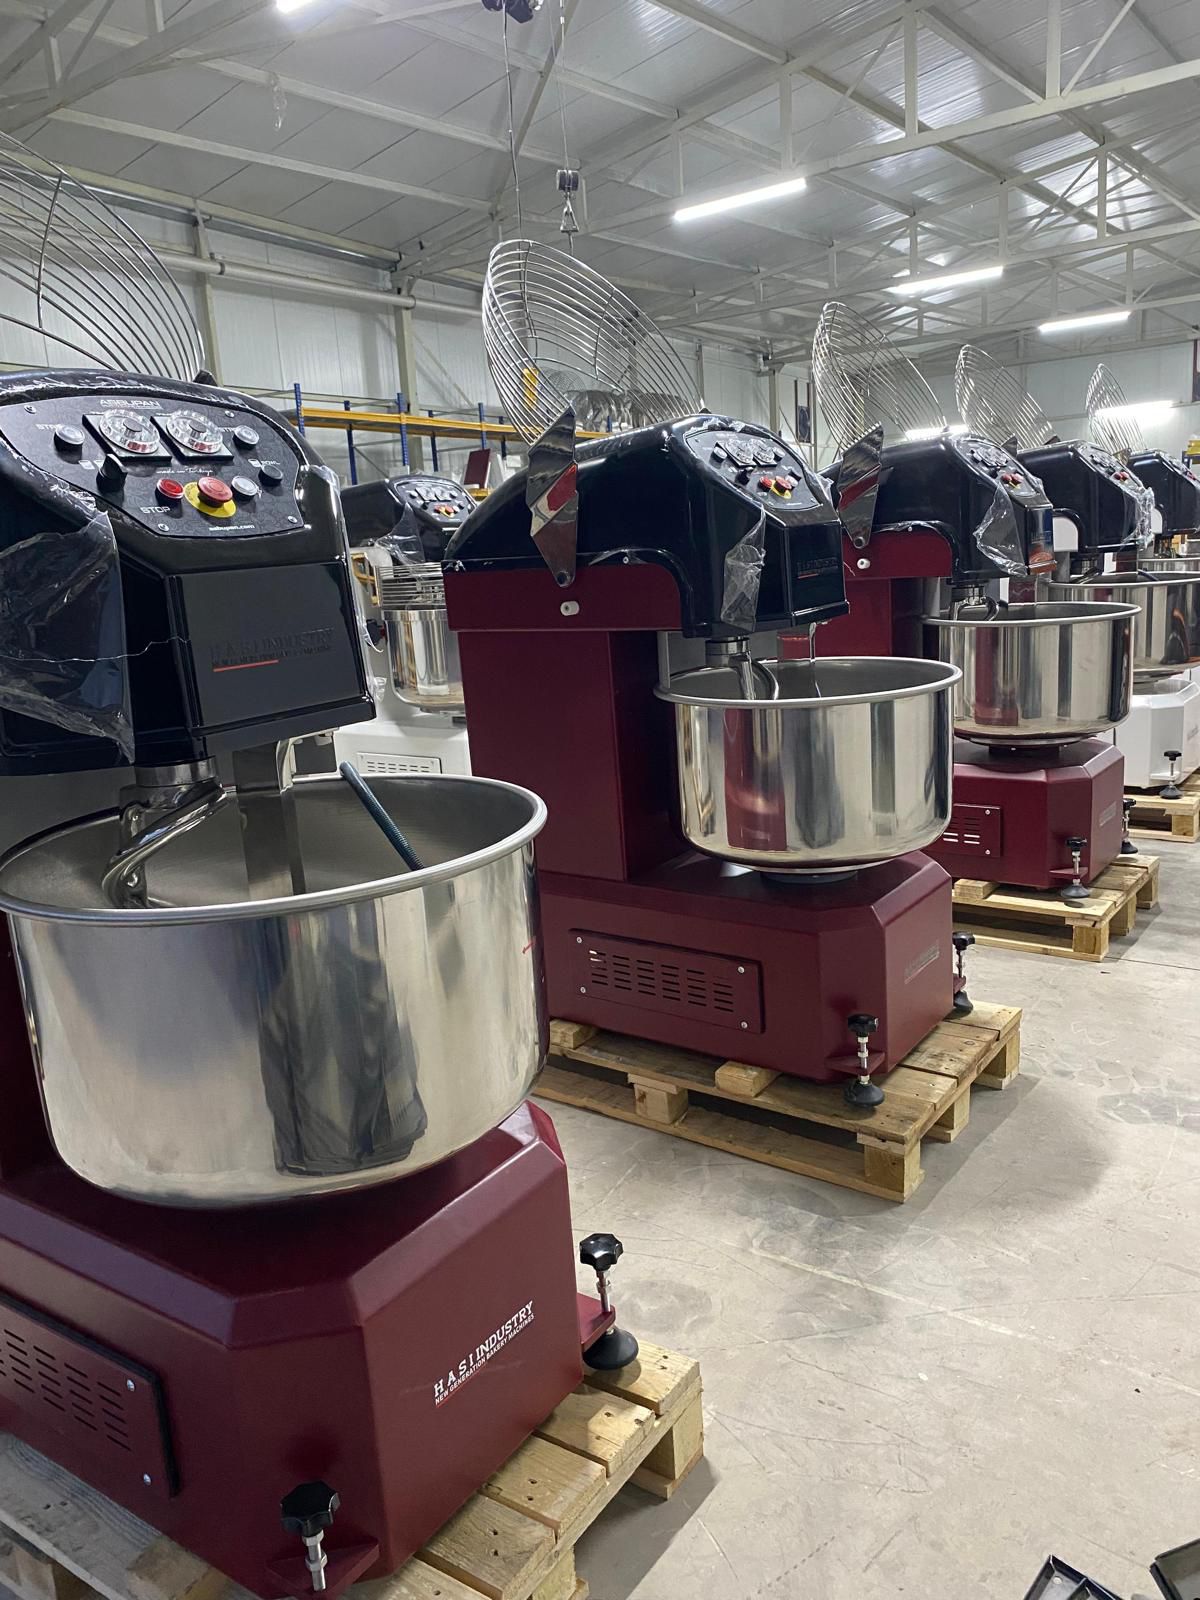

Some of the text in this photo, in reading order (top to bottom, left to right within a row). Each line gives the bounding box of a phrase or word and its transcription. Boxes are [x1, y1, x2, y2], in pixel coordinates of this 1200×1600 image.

[140, 506, 171, 514] STOP
[435, 1313, 535, 1406] NEW GENERATION BAKERY MACHINES
[476, 1300, 533, 1361] INDUSTRY
